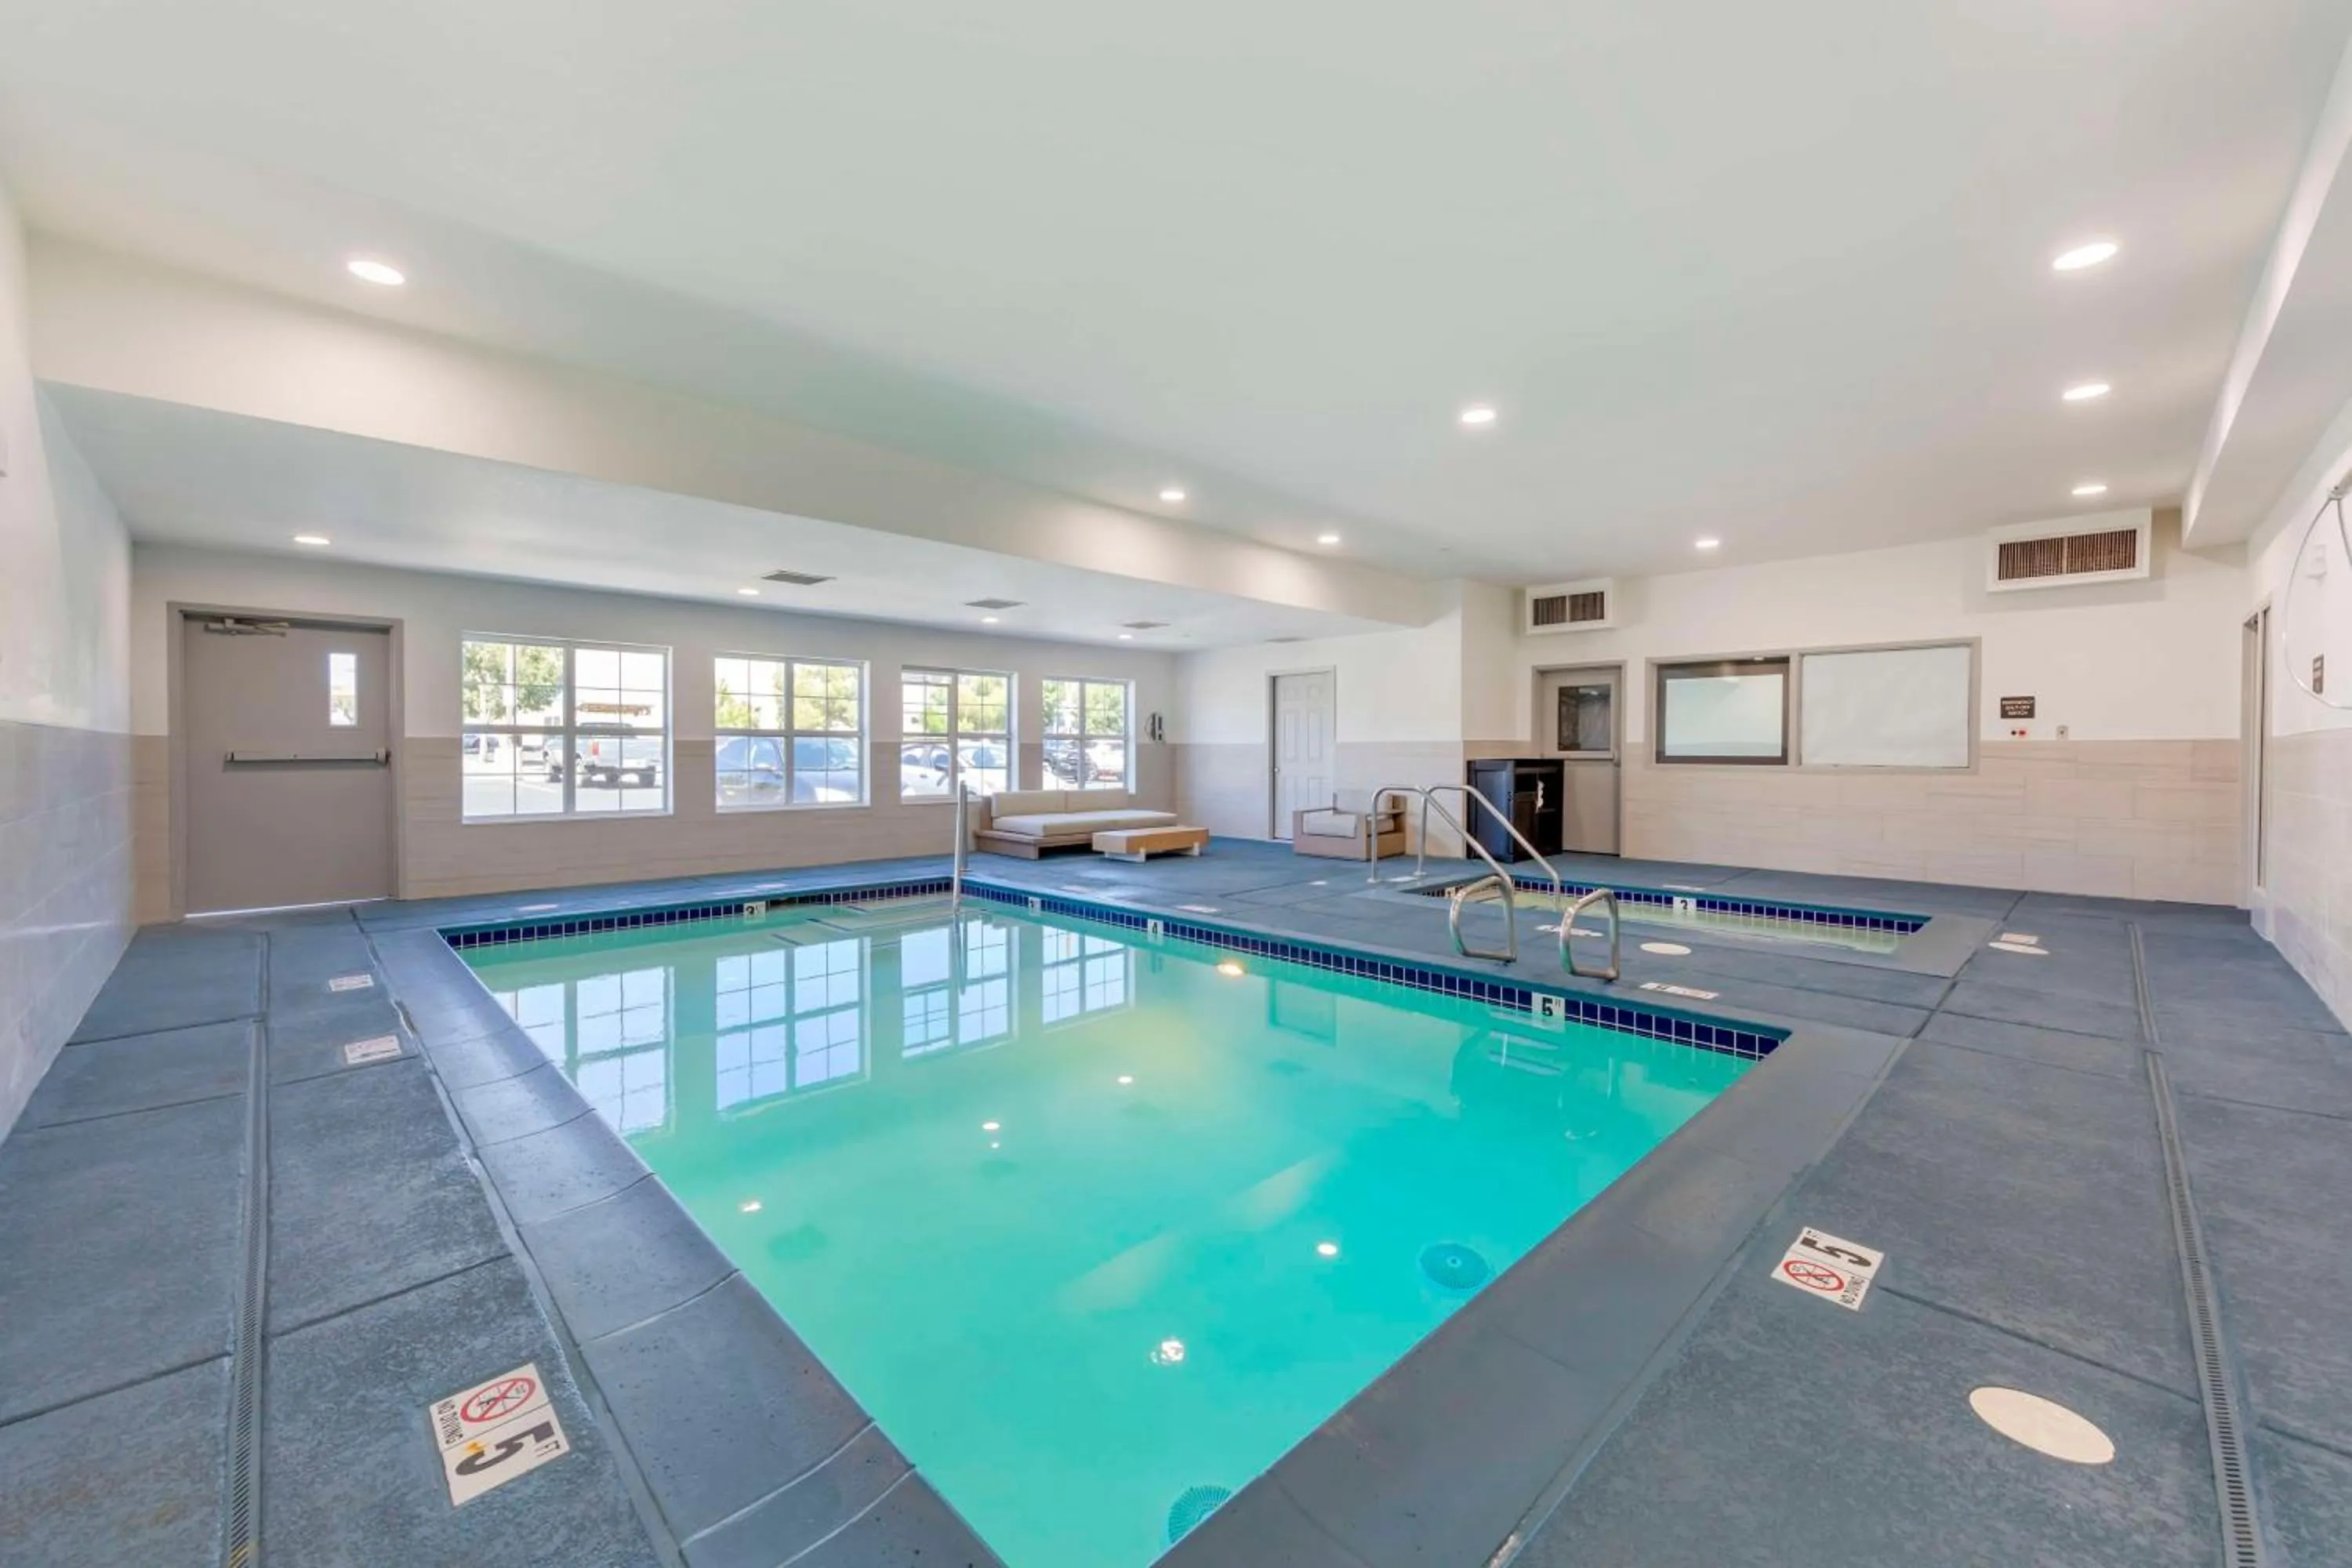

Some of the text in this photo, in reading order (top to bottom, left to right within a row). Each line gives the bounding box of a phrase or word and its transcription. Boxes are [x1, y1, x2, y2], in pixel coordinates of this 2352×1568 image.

[1542, 996, 1553, 1016] 5
[1801, 1237, 1871, 1267] 5
[436, 1399, 463, 1444] NO DIVING
[456, 1421, 554, 1475] 5
